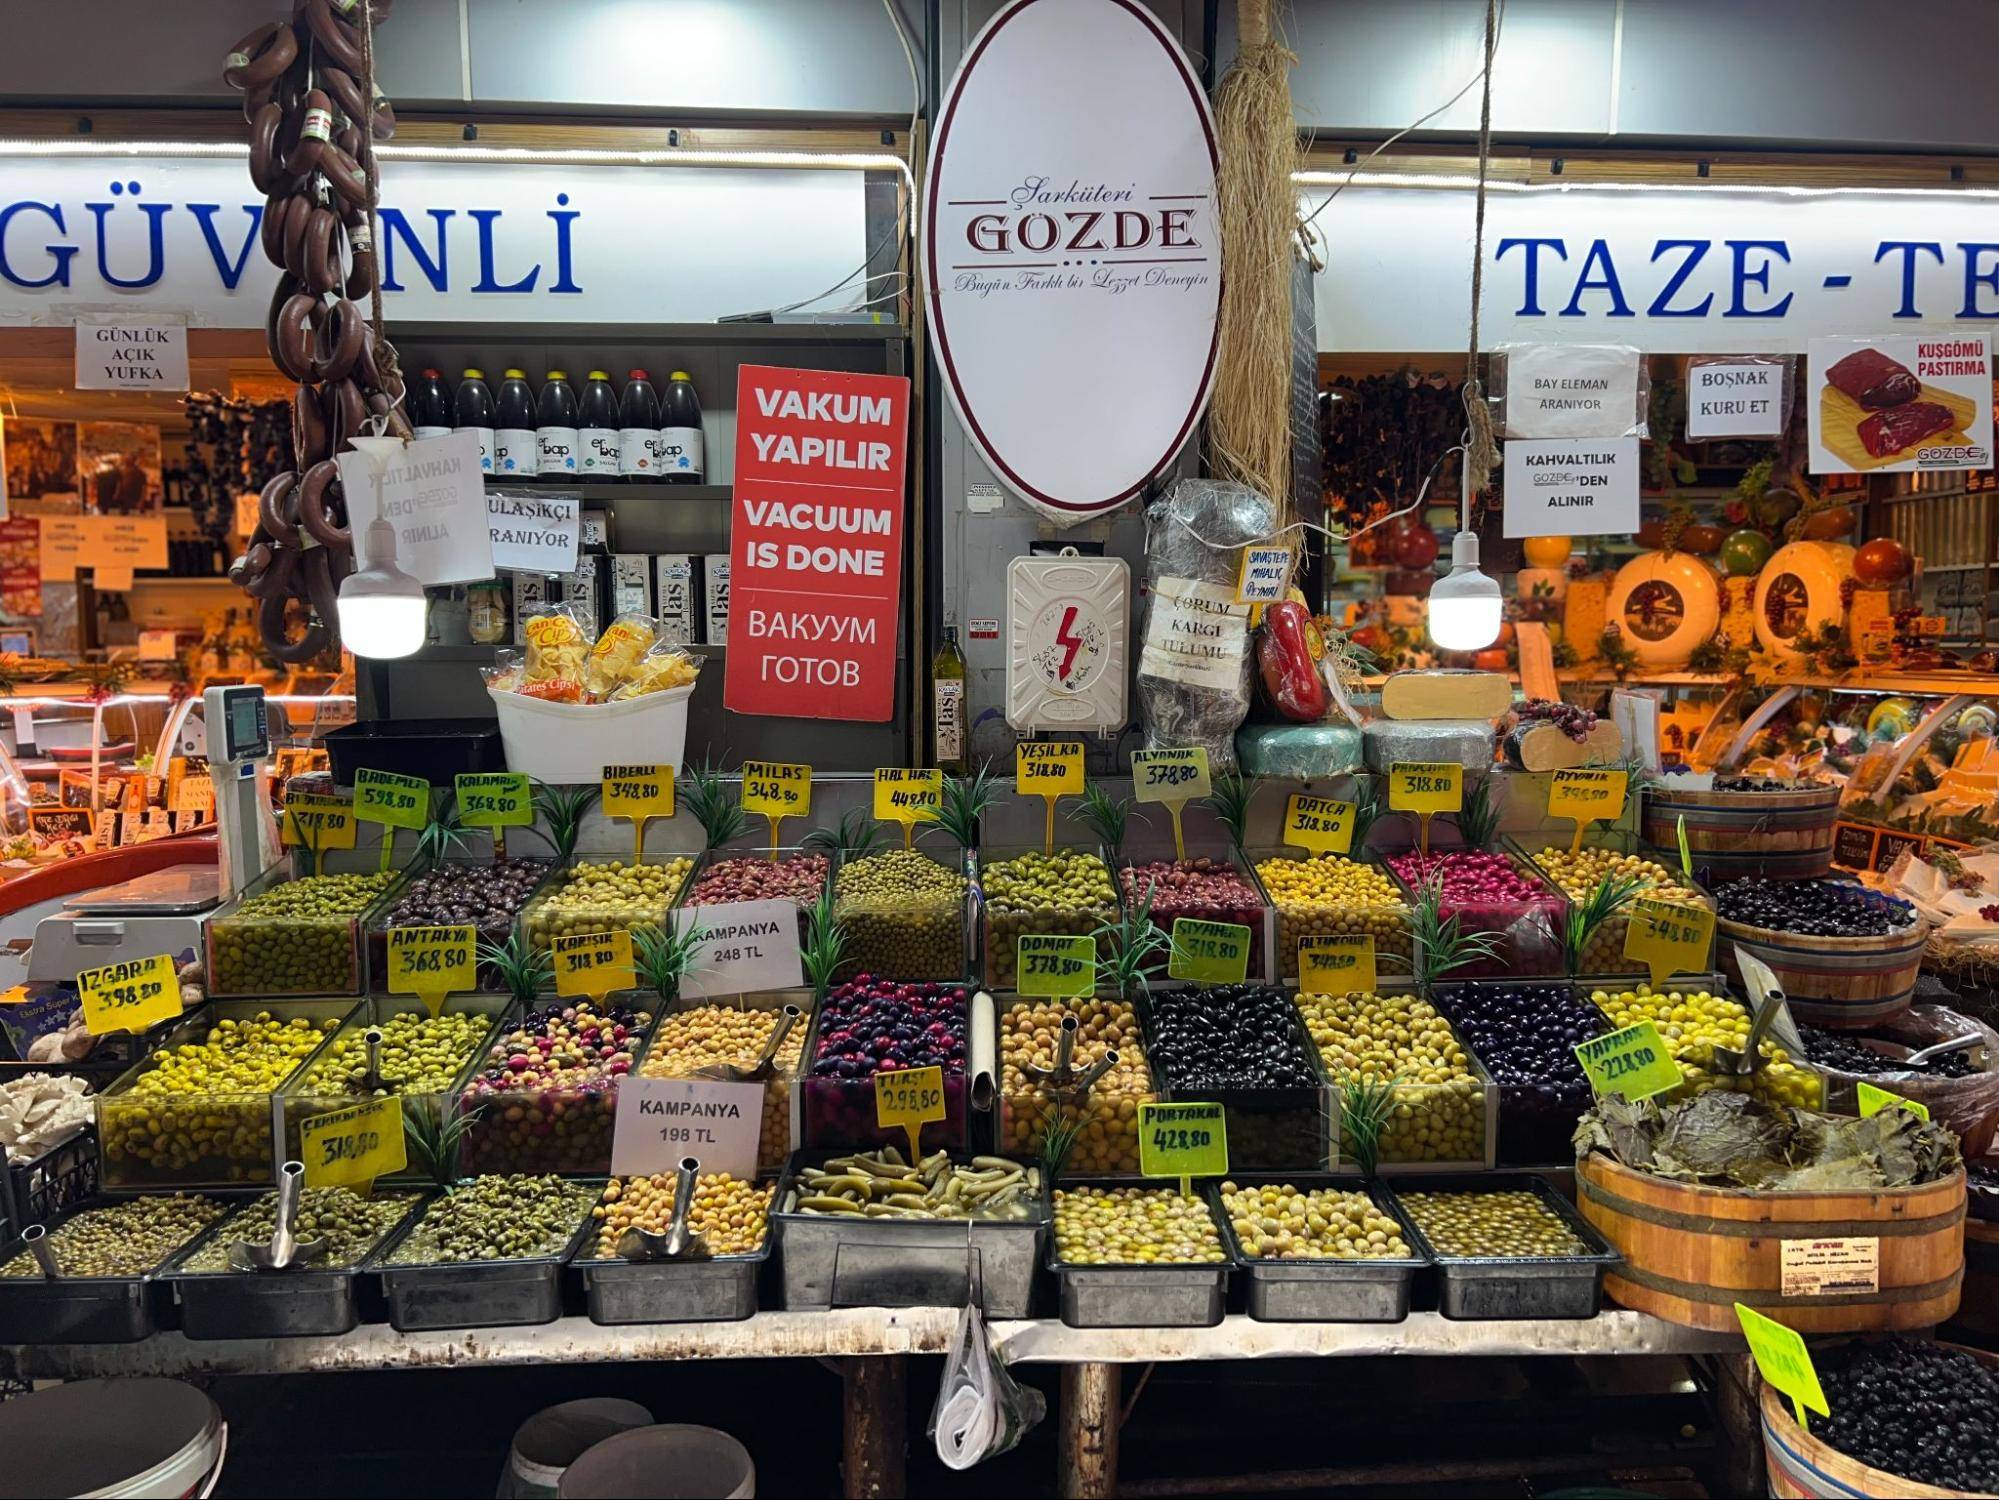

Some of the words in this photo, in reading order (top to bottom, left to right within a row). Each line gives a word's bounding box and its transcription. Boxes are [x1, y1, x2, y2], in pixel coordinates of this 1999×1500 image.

[1, 180, 583, 293] GÜVNLİ
[966, 209, 1202, 255] GÖZDE
[955, 272, 1011, 298] Bugün
[1067, 273, 1083, 290] bir
[1090, 268, 1140, 295] Lezzet
[1144, 266, 1209, 293] Deneyin
[1495, 238, 1794, 318] TAZE
[96, 327, 169, 344] GÜNLÜK
[112, 348, 155, 363] AÇIK
[1918, 340, 1983, 359] KUŞGÖMÜ
[104, 366, 163, 380] YUFKA
[1918, 361, 1985, 376] PASTIRMA
[1534, 378, 1558, 389] BAY
[1561, 379, 1608, 390] ELEMAN
[1701, 371, 1769, 388] BOŞNAK
[755, 387, 892, 426] VAKUM
[1540, 399, 1601, 410] ARANIYOR
[1700, 400, 1745, 416] KURU
[1750, 400, 1769, 414] ET
[750, 432, 891, 471] YAPILIR
[1526, 453, 1616, 466] KAHVALTILIK
[1547, 495, 1594, 507] ALINIR
[743, 499, 892, 536] VACUUM
[489, 528, 569, 548] RANIYOR
[747, 541, 779, 569] IS
[787, 545, 885, 577] DONE
[1174, 595, 1231, 616] ÇORUM
[748, 610, 877, 644] ВАКУУМ
[1172, 619, 1222, 637] KARGI
[761, 655, 861, 687] ГОТОВ
[391, 929, 468, 948] ANTAKYA
[714, 948, 740, 962] 248
[745, 946, 763, 959] TL
[639, 1099, 740, 1118] KAMPANYA
[659, 1129, 690, 1143] 198
[696, 1129, 716, 1143] TL
